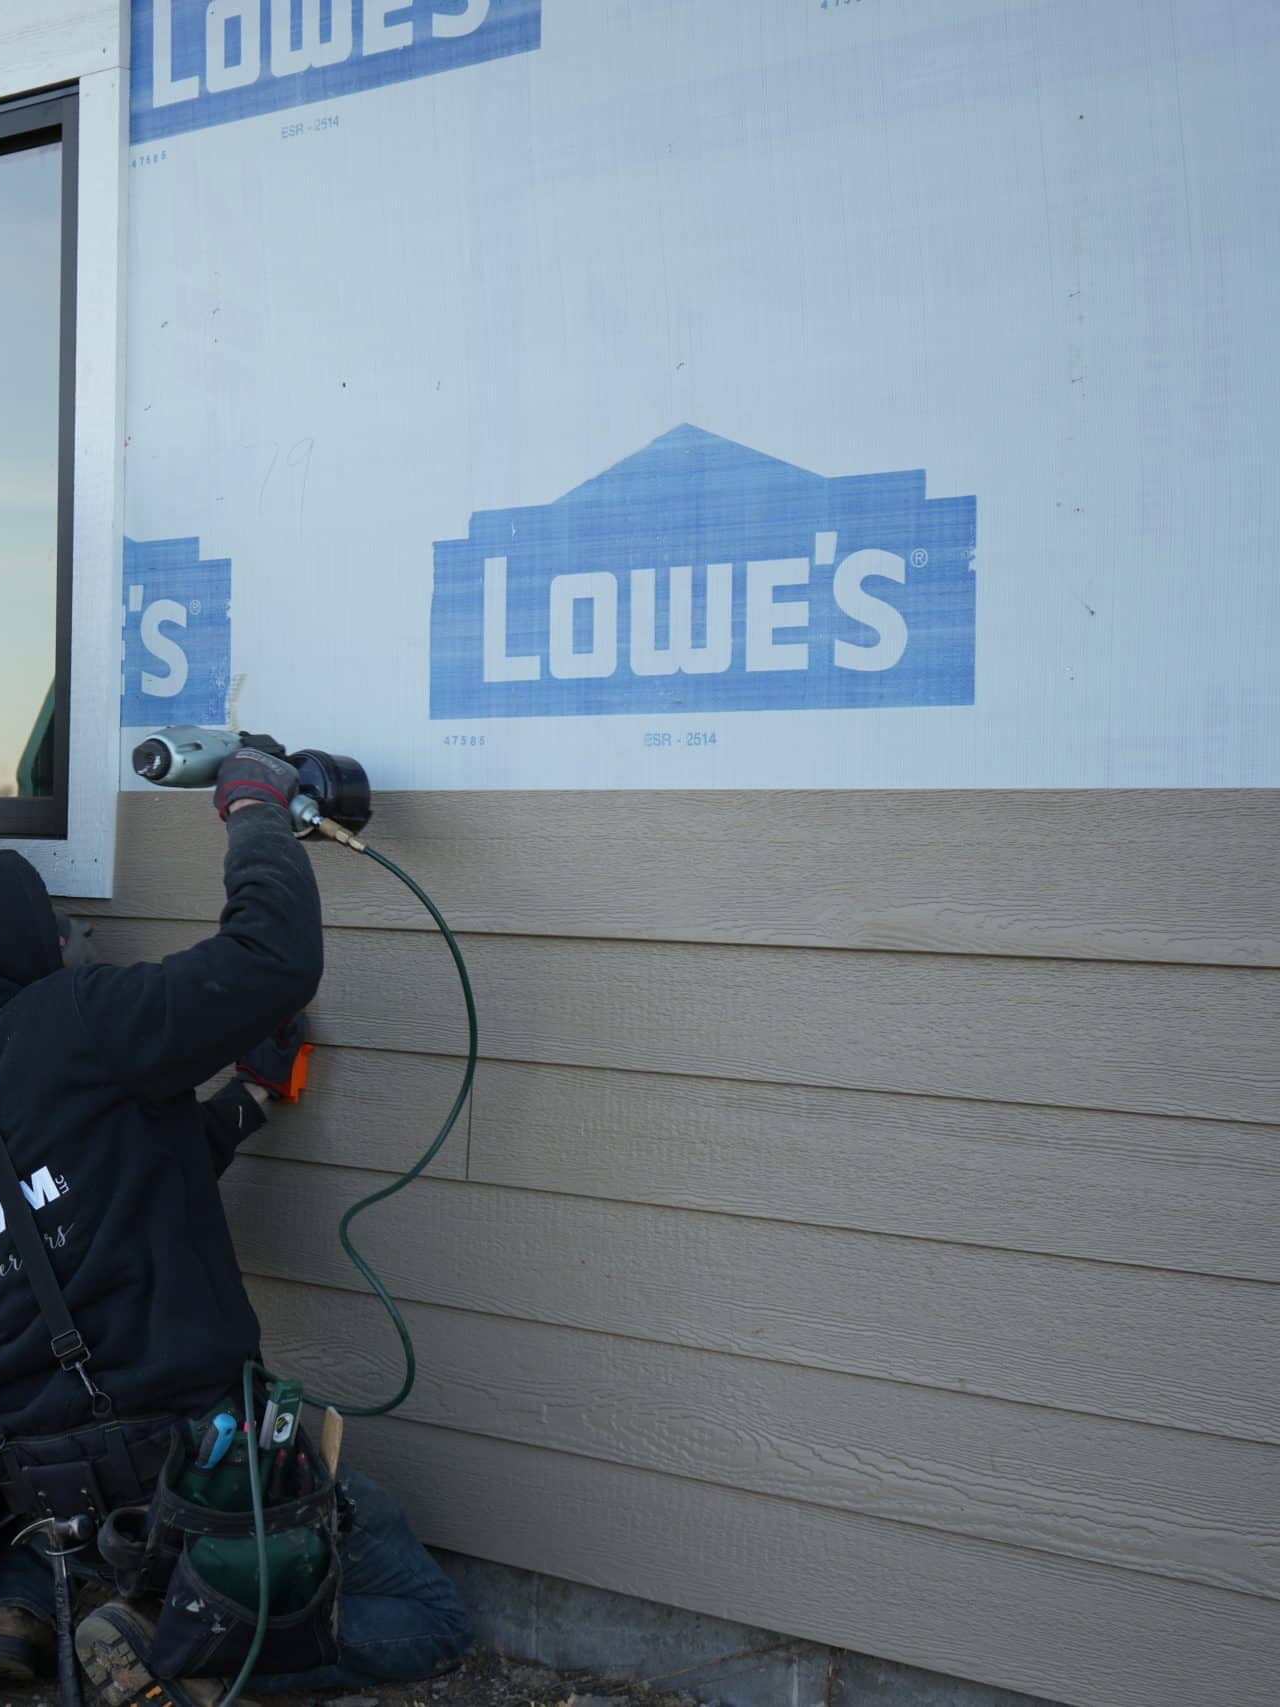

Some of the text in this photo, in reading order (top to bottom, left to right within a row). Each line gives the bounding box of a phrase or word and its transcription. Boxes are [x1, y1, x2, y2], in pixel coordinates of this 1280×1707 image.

[483, 531, 909, 683] LOWE'S
[644, 733, 671, 747] ESR
[687, 732, 717, 746] 2514
